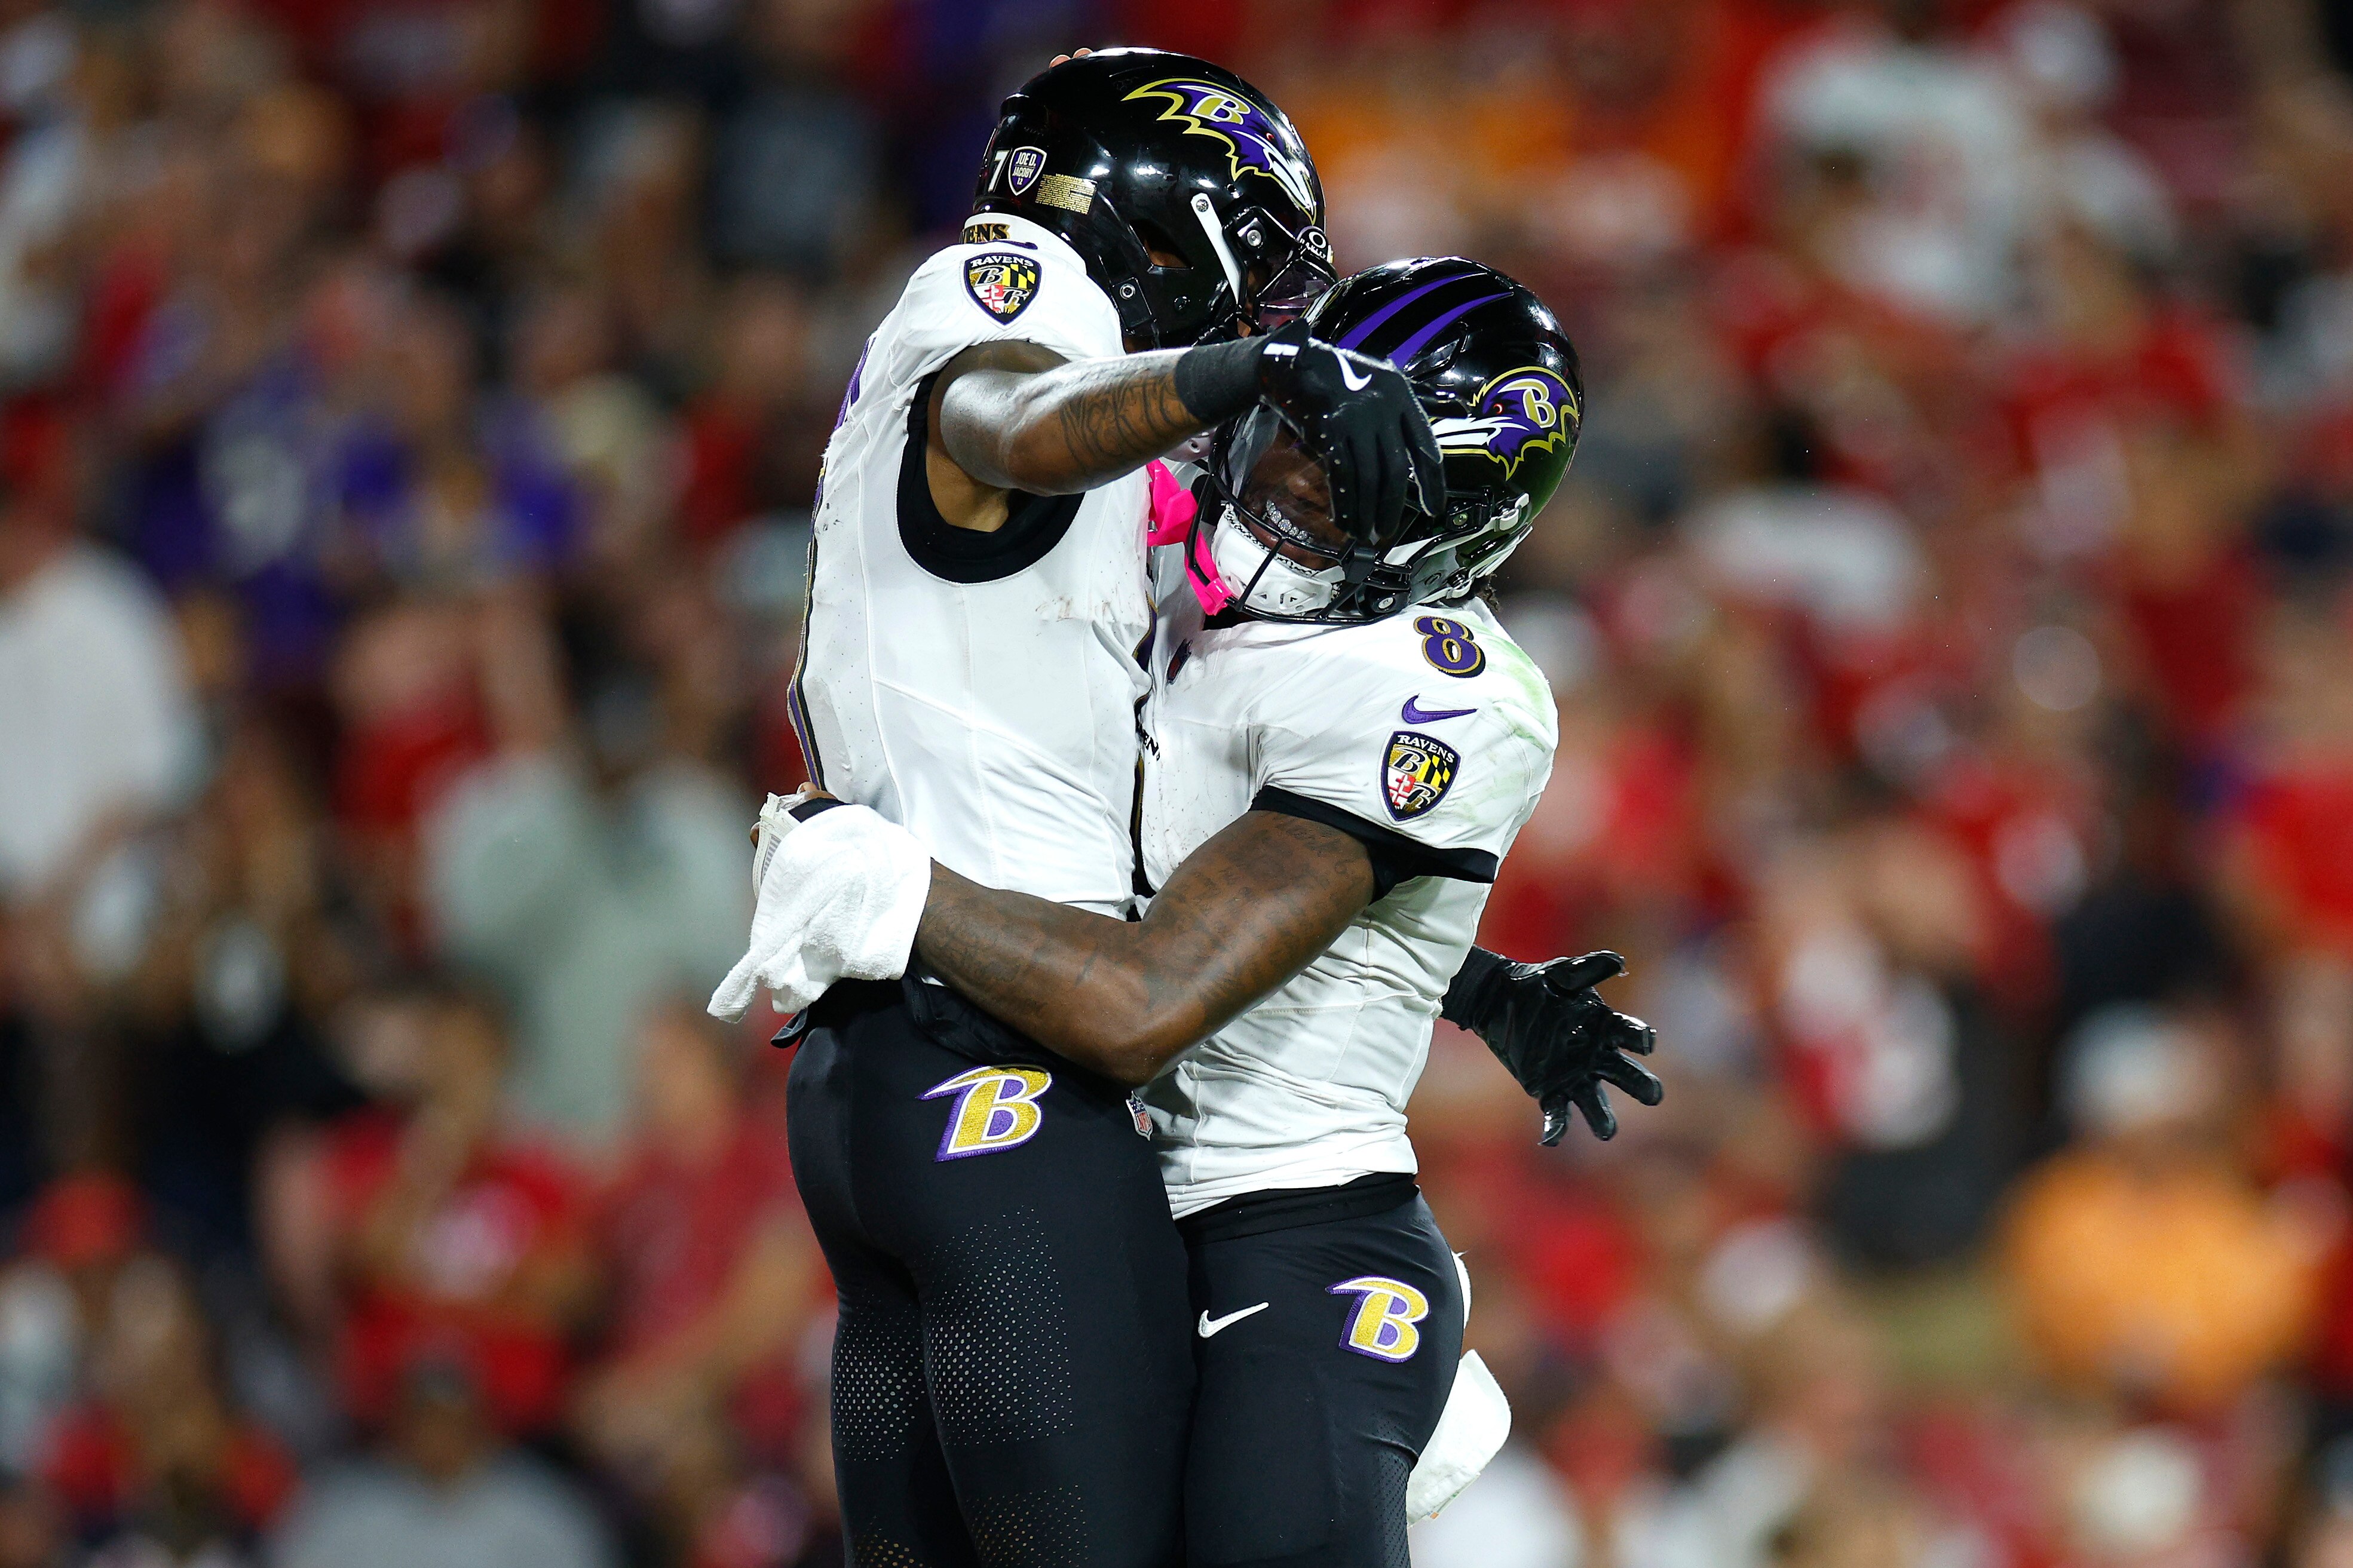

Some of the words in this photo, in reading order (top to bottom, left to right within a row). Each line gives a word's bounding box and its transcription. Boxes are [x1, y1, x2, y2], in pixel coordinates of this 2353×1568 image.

[1176, 85, 1251, 125] B
[988, 150, 1010, 192] 7
[1012, 166, 1034, 179] JACOBY
[1015, 152, 1031, 165] JOE
[1028, 153, 1037, 167] D.
[970, 255, 1034, 268] RAVENS
[970, 265, 1004, 287] B
[1497, 378, 1557, 428] B
[1413, 615, 1486, 678] 8
[1392, 747, 1427, 774] B
[1398, 735, 1455, 763] RAVENS
[915, 1064, 1056, 1162] B
[1325, 1275, 1430, 1363] B
